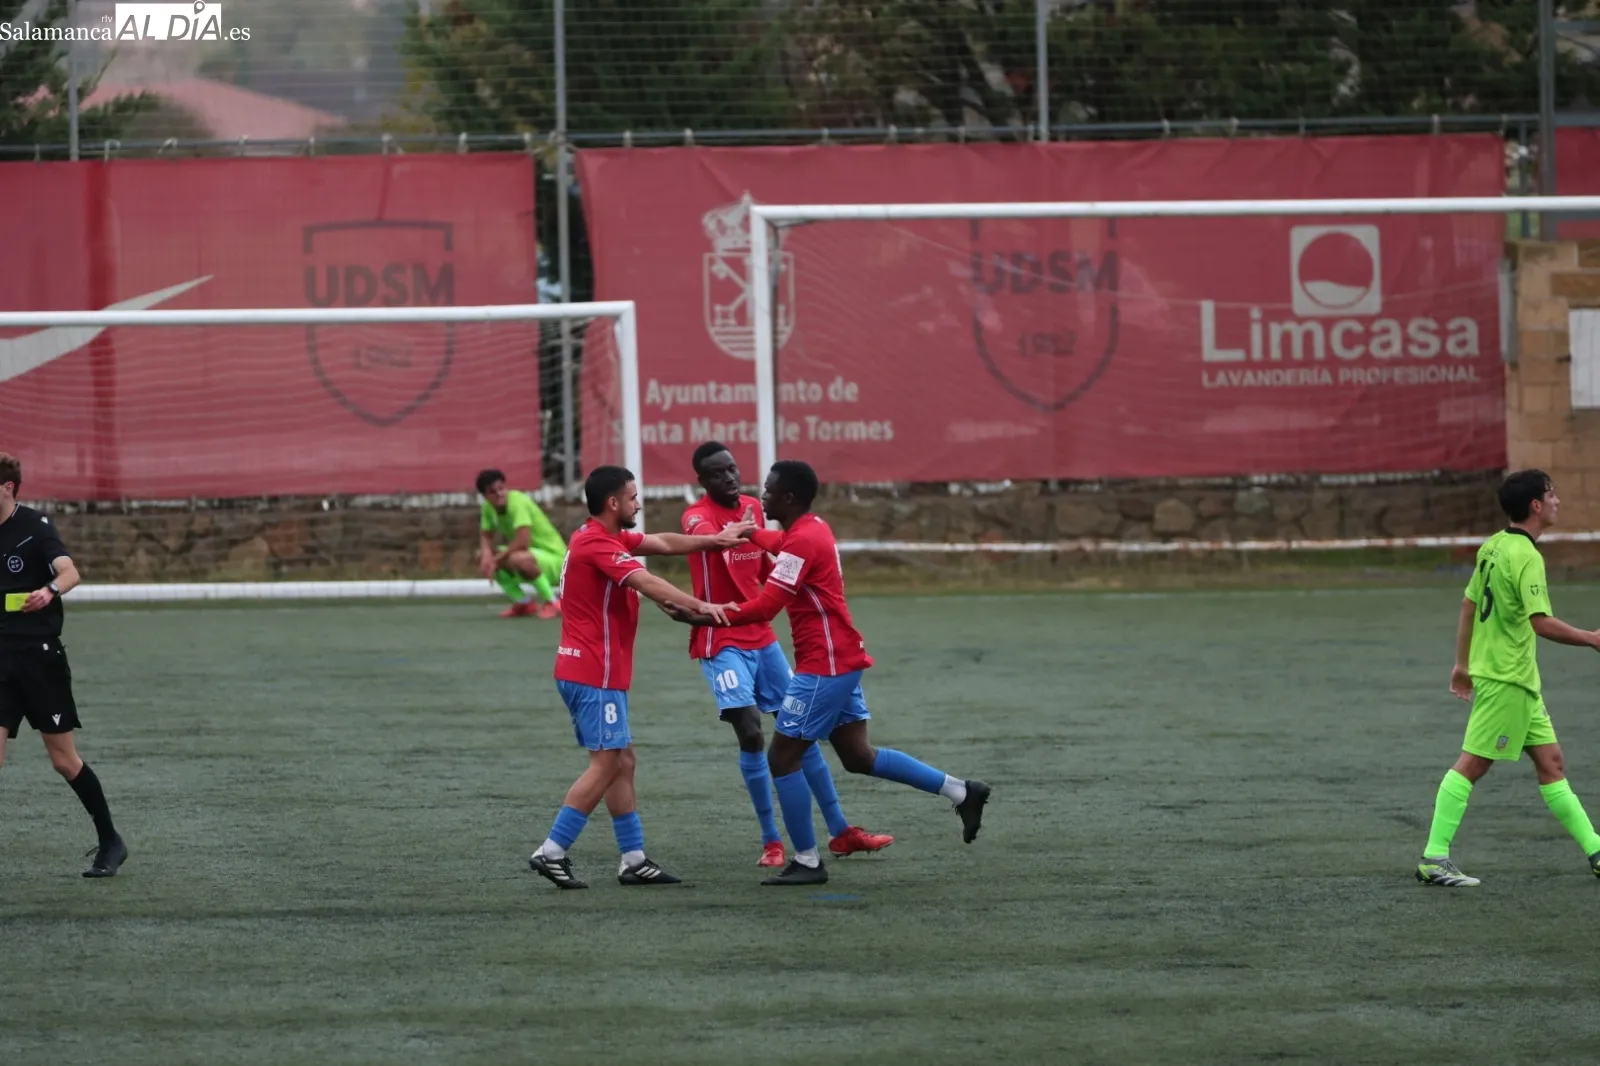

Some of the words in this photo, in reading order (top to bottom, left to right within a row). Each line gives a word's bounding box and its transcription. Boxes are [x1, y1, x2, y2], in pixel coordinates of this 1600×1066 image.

[304, 262, 455, 308] UDSM
[971, 251, 1119, 294] UDSM
[1201, 299, 1480, 362] Limcasa
[1338, 364, 1480, 385] PROFESIONAL
[646, 377, 822, 412] Ayuntamnto
[828, 376, 859, 401] de
[611, 418, 684, 444] Snta
[805, 415, 894, 441] Tormes
[716, 669, 739, 693] 10
[604, 703, 618, 725] 8
